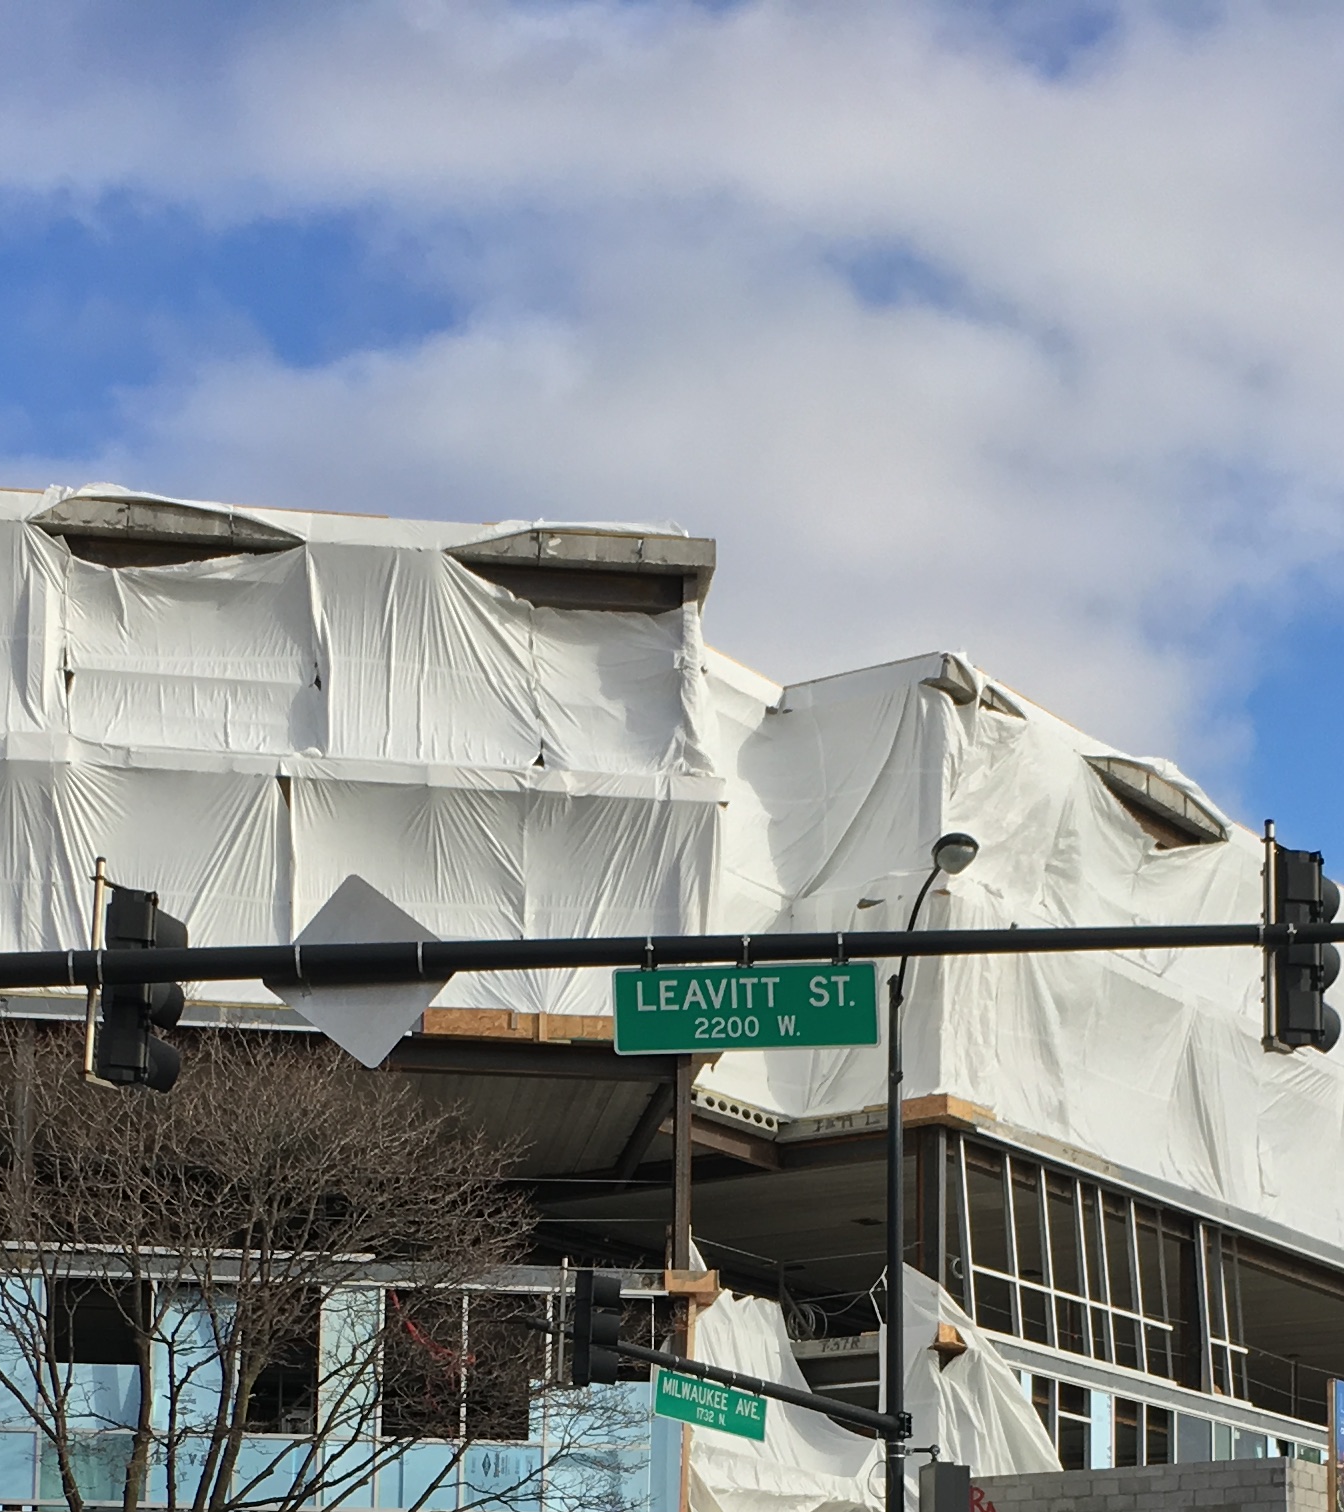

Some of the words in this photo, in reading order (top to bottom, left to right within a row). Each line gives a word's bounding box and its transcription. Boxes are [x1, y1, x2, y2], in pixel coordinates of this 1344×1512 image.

[636, 976, 780, 1011] LEAVITT
[808, 975, 856, 1008] ST.
[694, 1016, 760, 1039] 2200
[777, 1015, 801, 1037] W.
[663, 1377, 728, 1410] MILWAUKEE
[736, 1400, 760, 1420] AVE.
[696, 1407, 714, 1423] 1732
